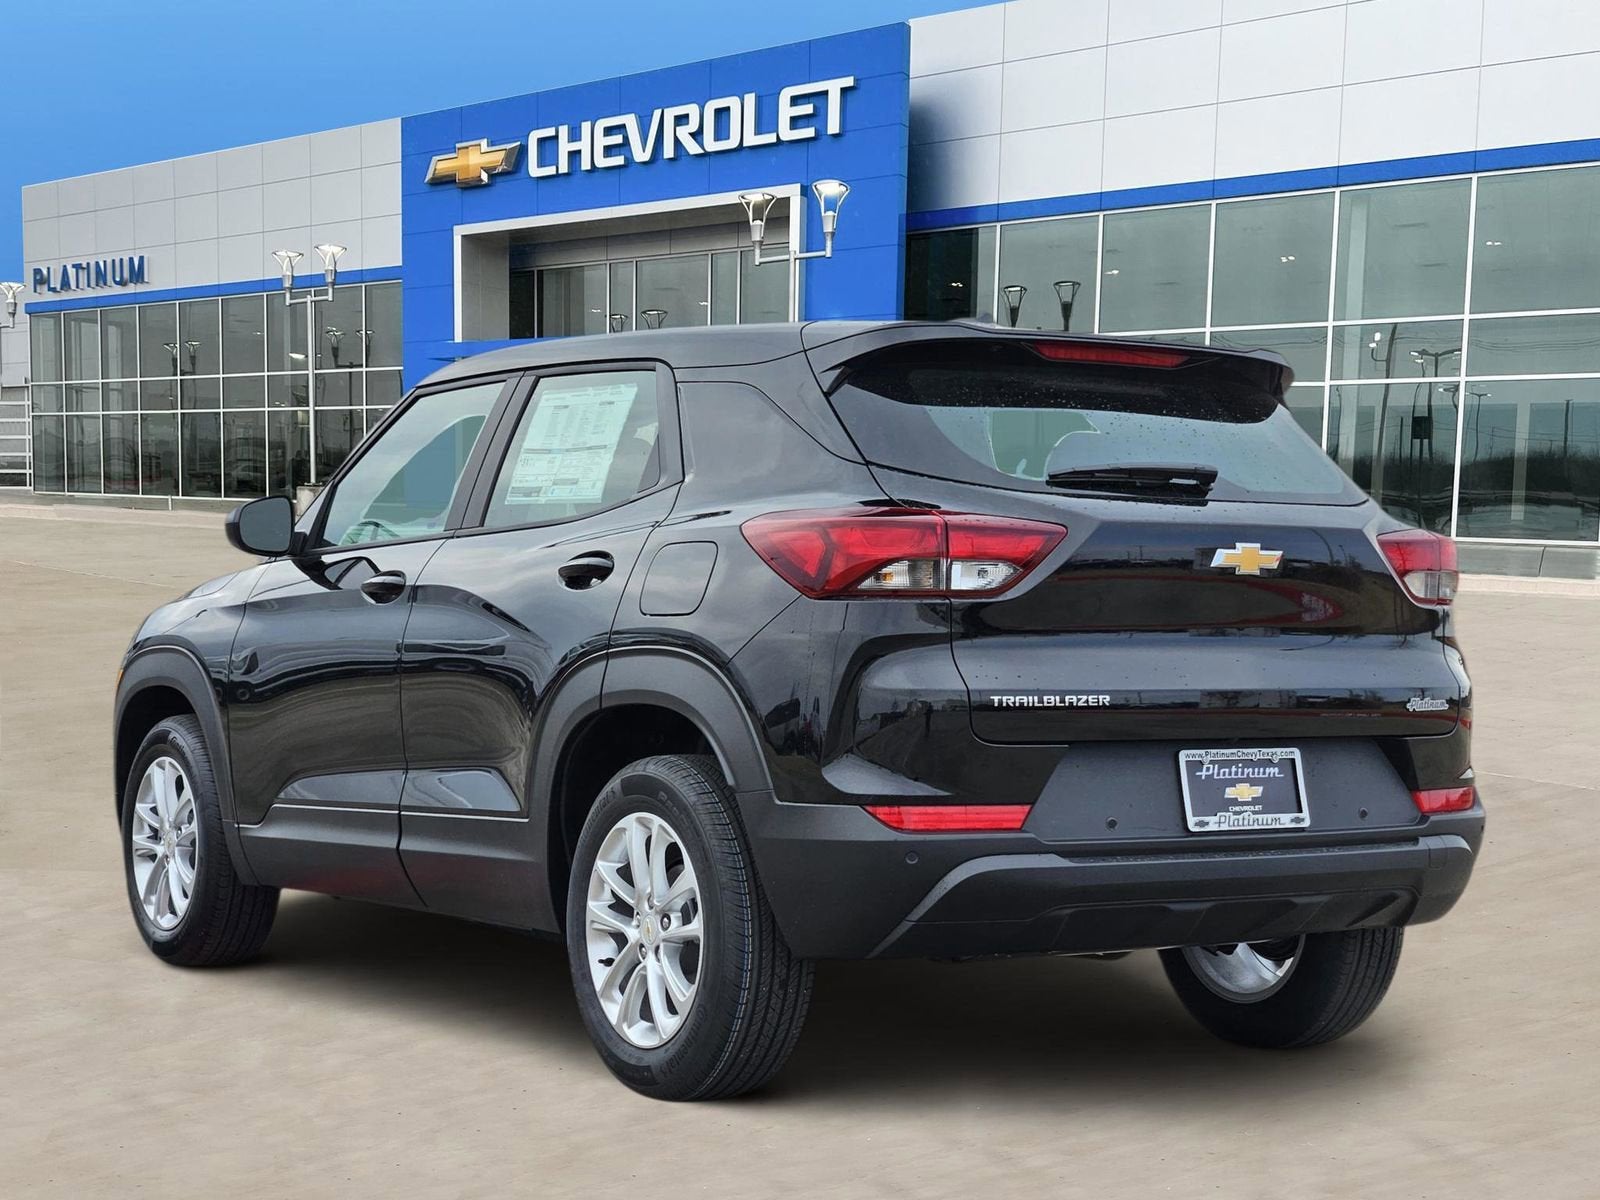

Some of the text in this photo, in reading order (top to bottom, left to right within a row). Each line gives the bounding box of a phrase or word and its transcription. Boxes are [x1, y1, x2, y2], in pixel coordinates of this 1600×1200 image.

[527, 75, 856, 178] CHEVROLET
[33, 255, 147, 294] PLATINUM
[990, 694, 1111, 707] TRAILBLAZER
[1185, 749, 1296, 760] www.PlatinumChevyTexas.com
[1195, 763, 1284, 780] Platinum
[1228, 804, 1263, 812] CHEVROLET
[1214, 811, 1286, 828] Platinum
